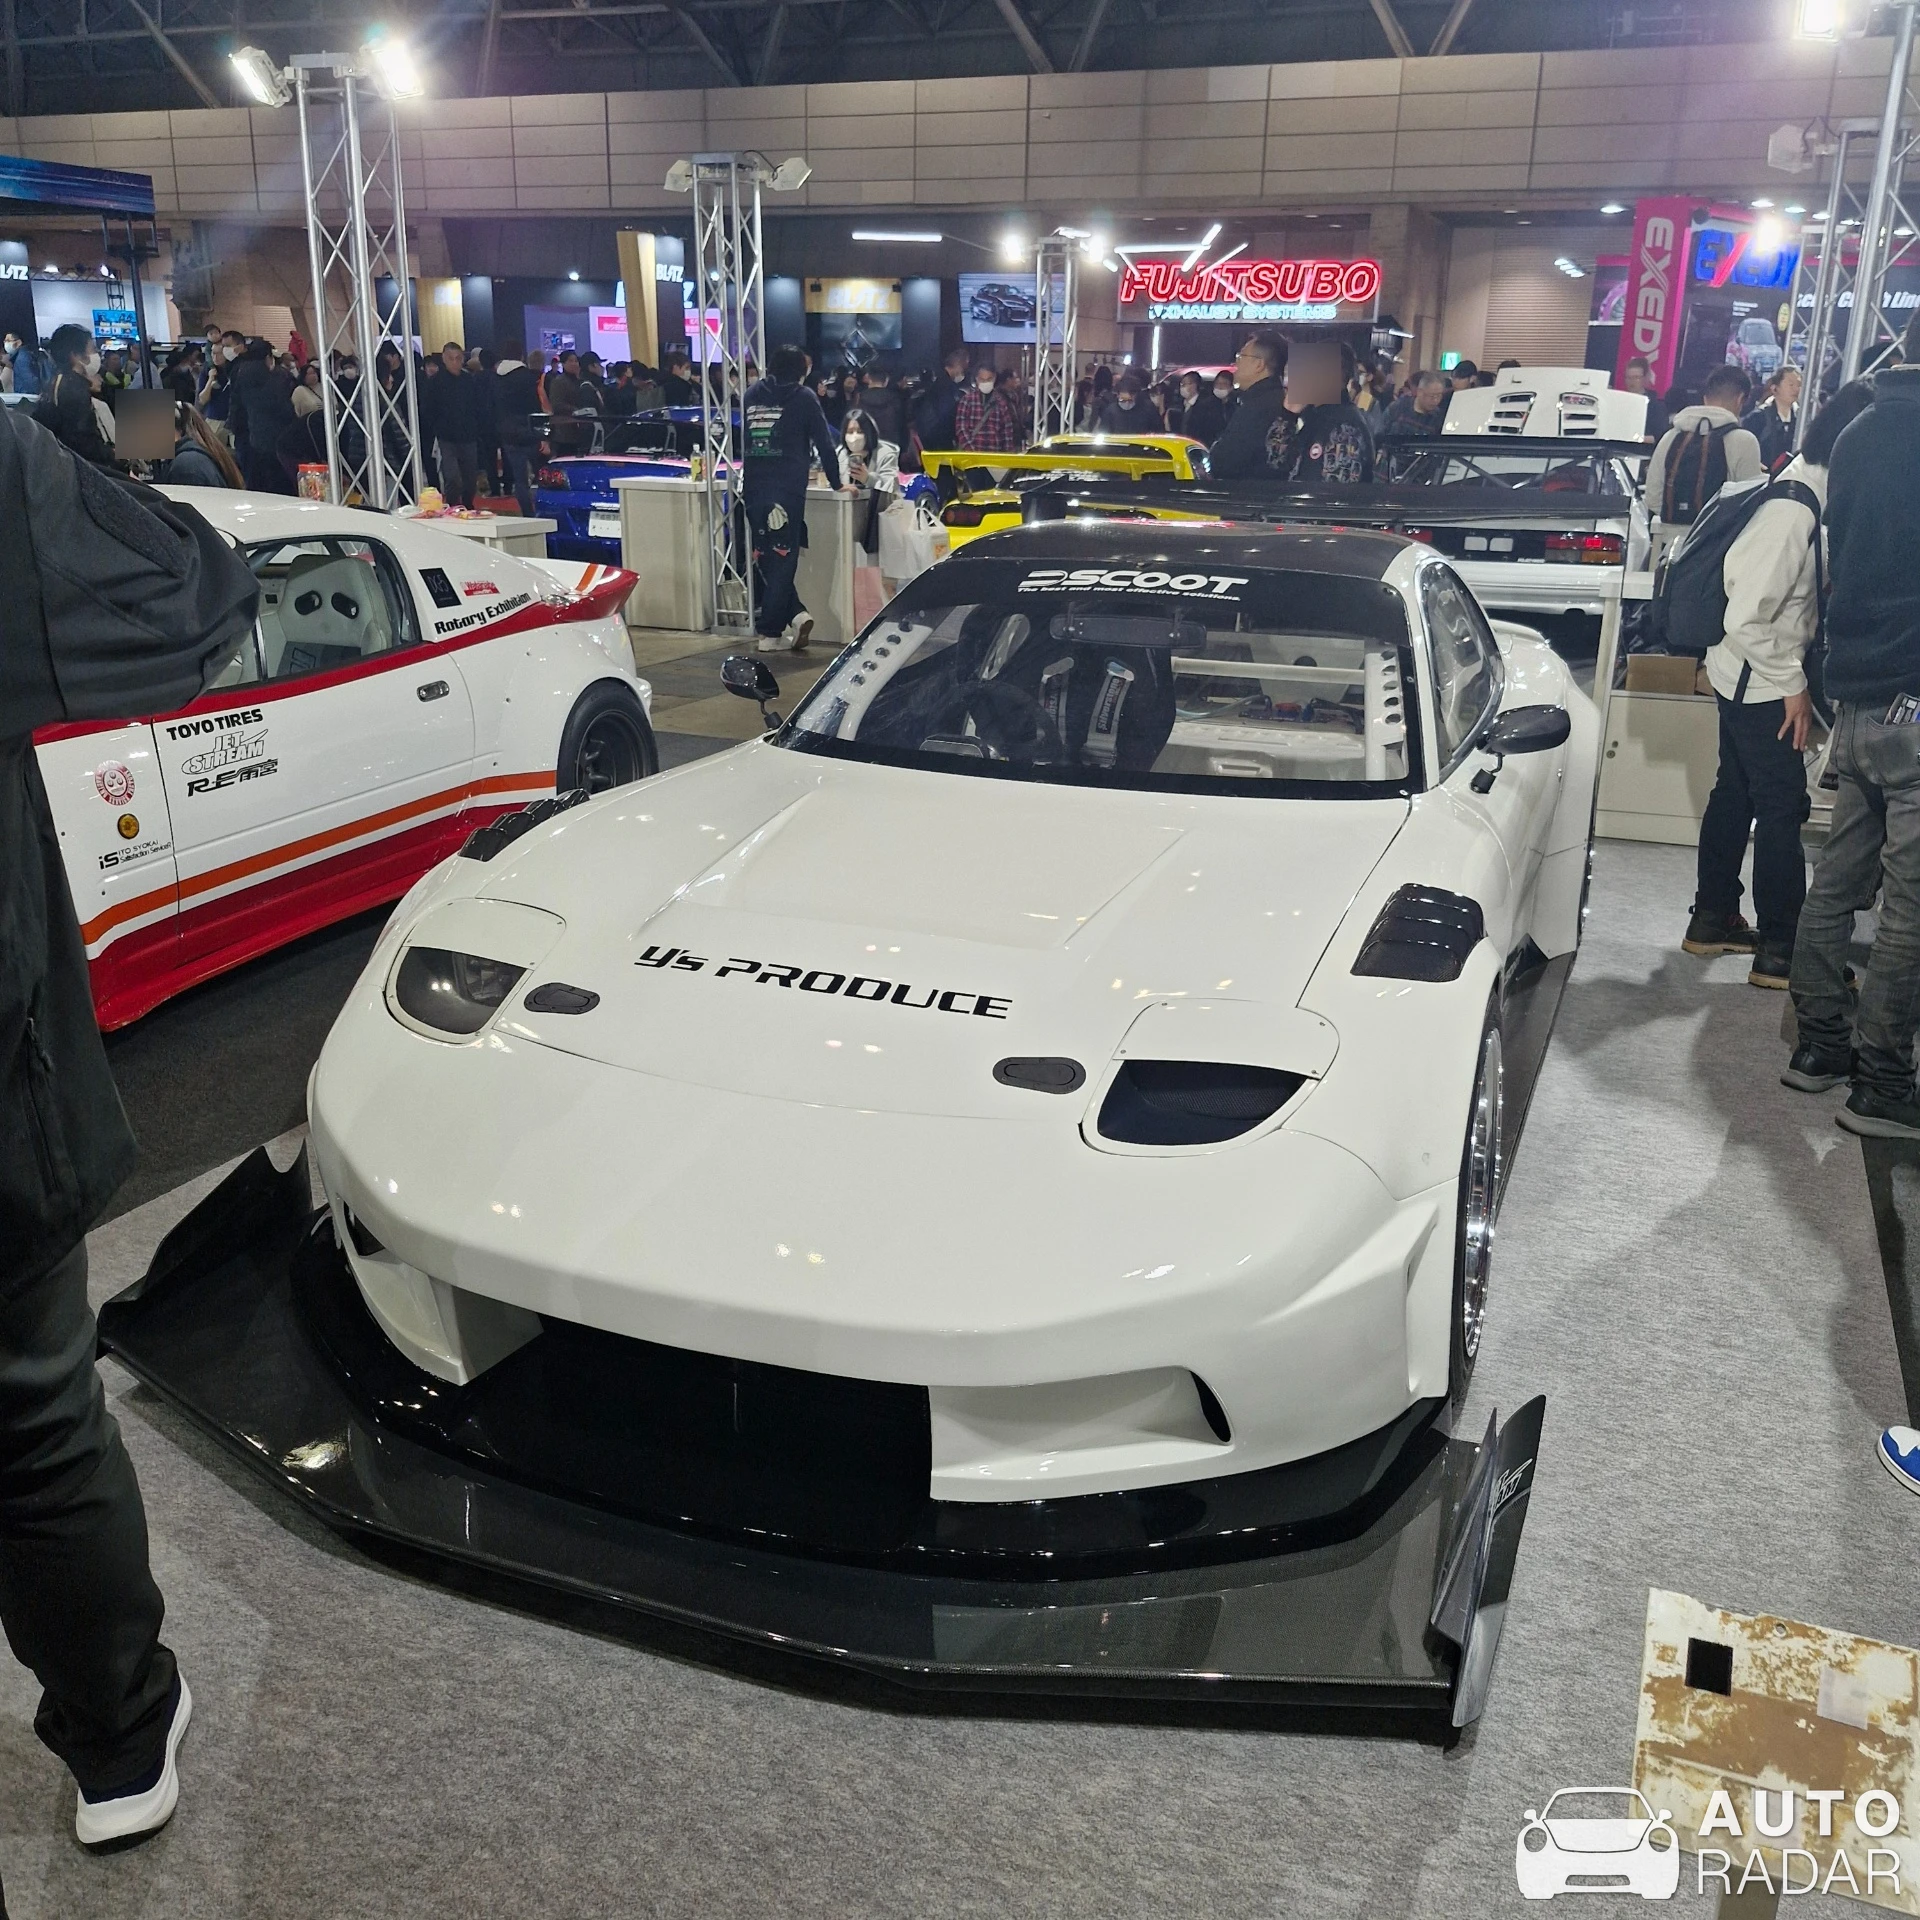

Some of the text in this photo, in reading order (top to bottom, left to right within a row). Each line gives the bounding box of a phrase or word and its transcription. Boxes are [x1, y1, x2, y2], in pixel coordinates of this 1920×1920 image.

[656, 263, 684, 283] BLITZ
[1121, 260, 1383, 303] FUJITSUBO
[827, 286, 893, 310] BLITZ
[1243, 304, 1337, 320] SYSTEMS
[1126, 587, 1180, 596] effective
[434, 592, 532, 635] Rotary Exhibition
[166, 708, 264, 740] TOYO TIRES
[214, 730, 245, 752] JET
[188, 740, 265, 775] STREAM
[118, 840, 159, 857] ITO SYOKAI
[714, 958, 1013, 1020] PRODUCE
